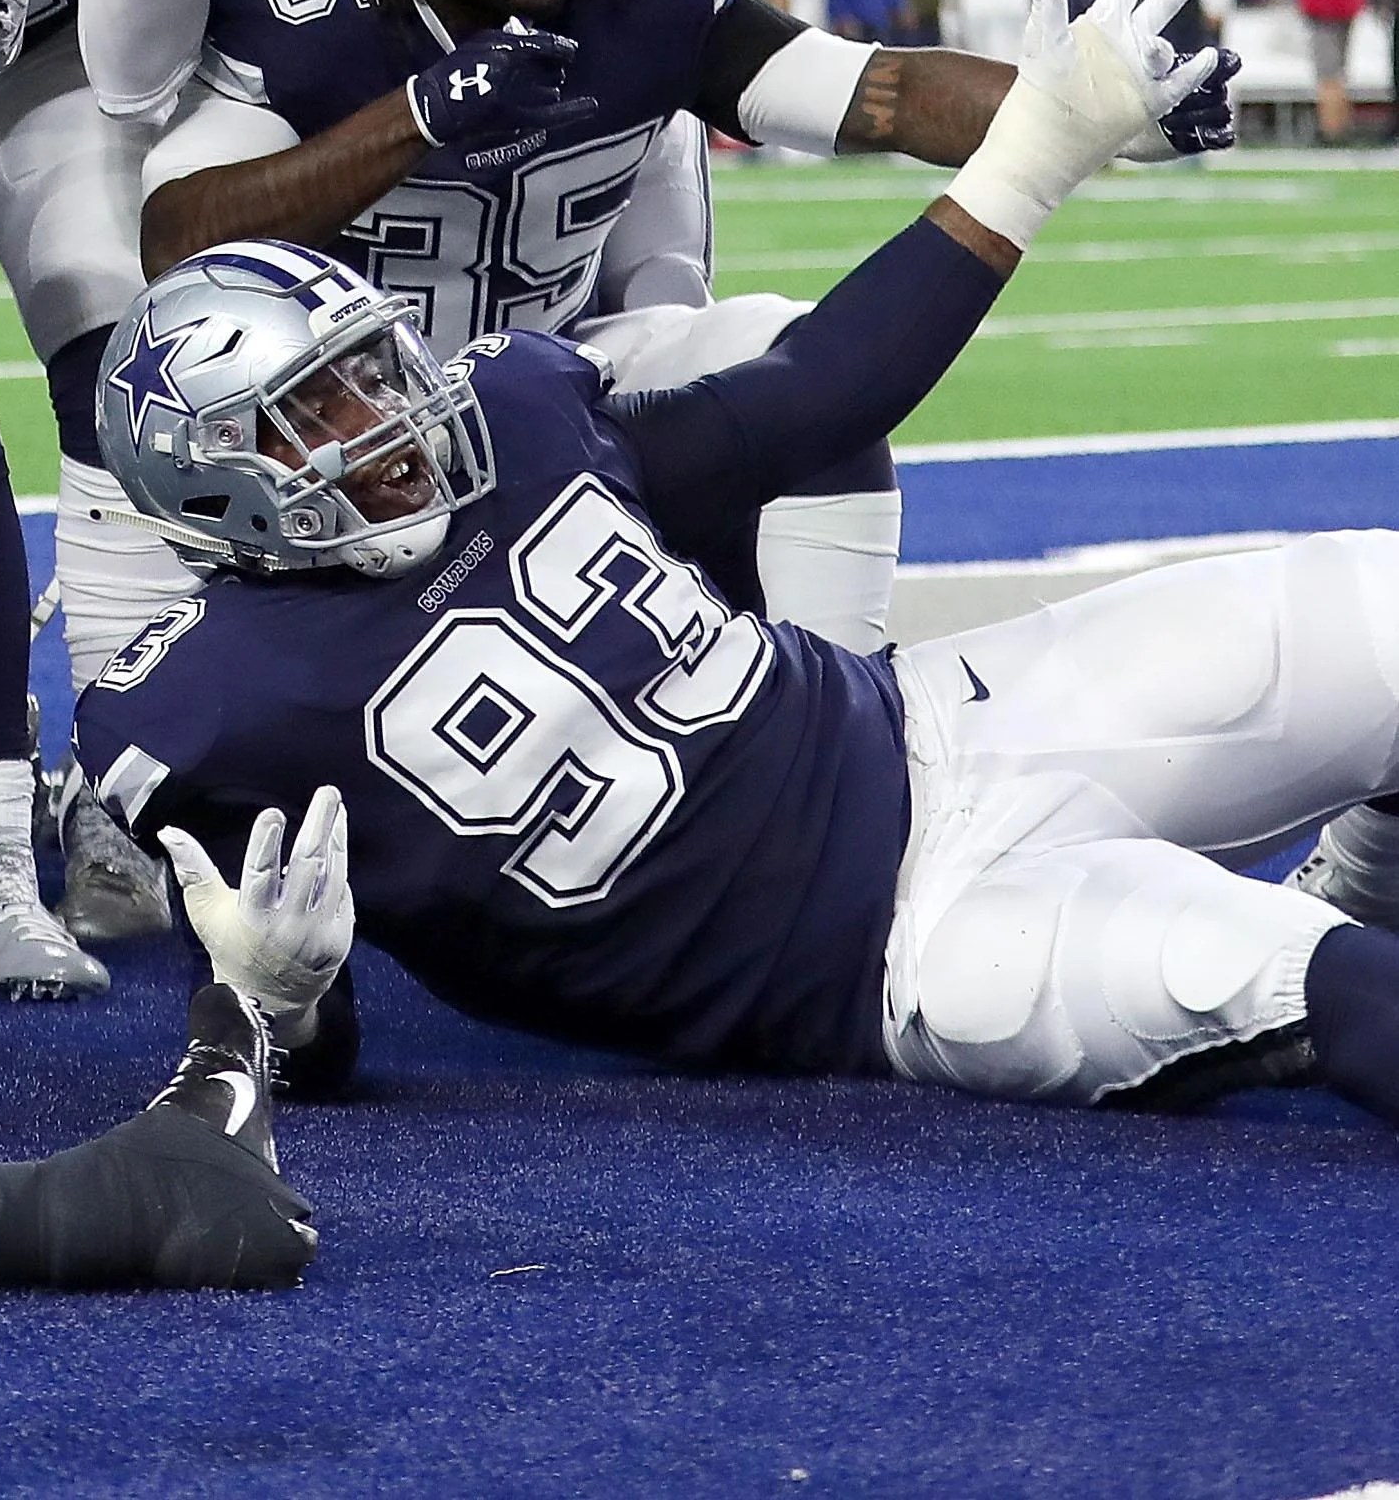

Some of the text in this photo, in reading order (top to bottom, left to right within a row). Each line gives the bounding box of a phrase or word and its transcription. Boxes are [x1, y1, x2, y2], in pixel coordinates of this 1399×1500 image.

[465, 129, 548, 170] COWBOYS
[342, 116, 667, 352] 35
[417, 531, 495, 614] COWBOYS
[364, 471, 776, 909] 93
